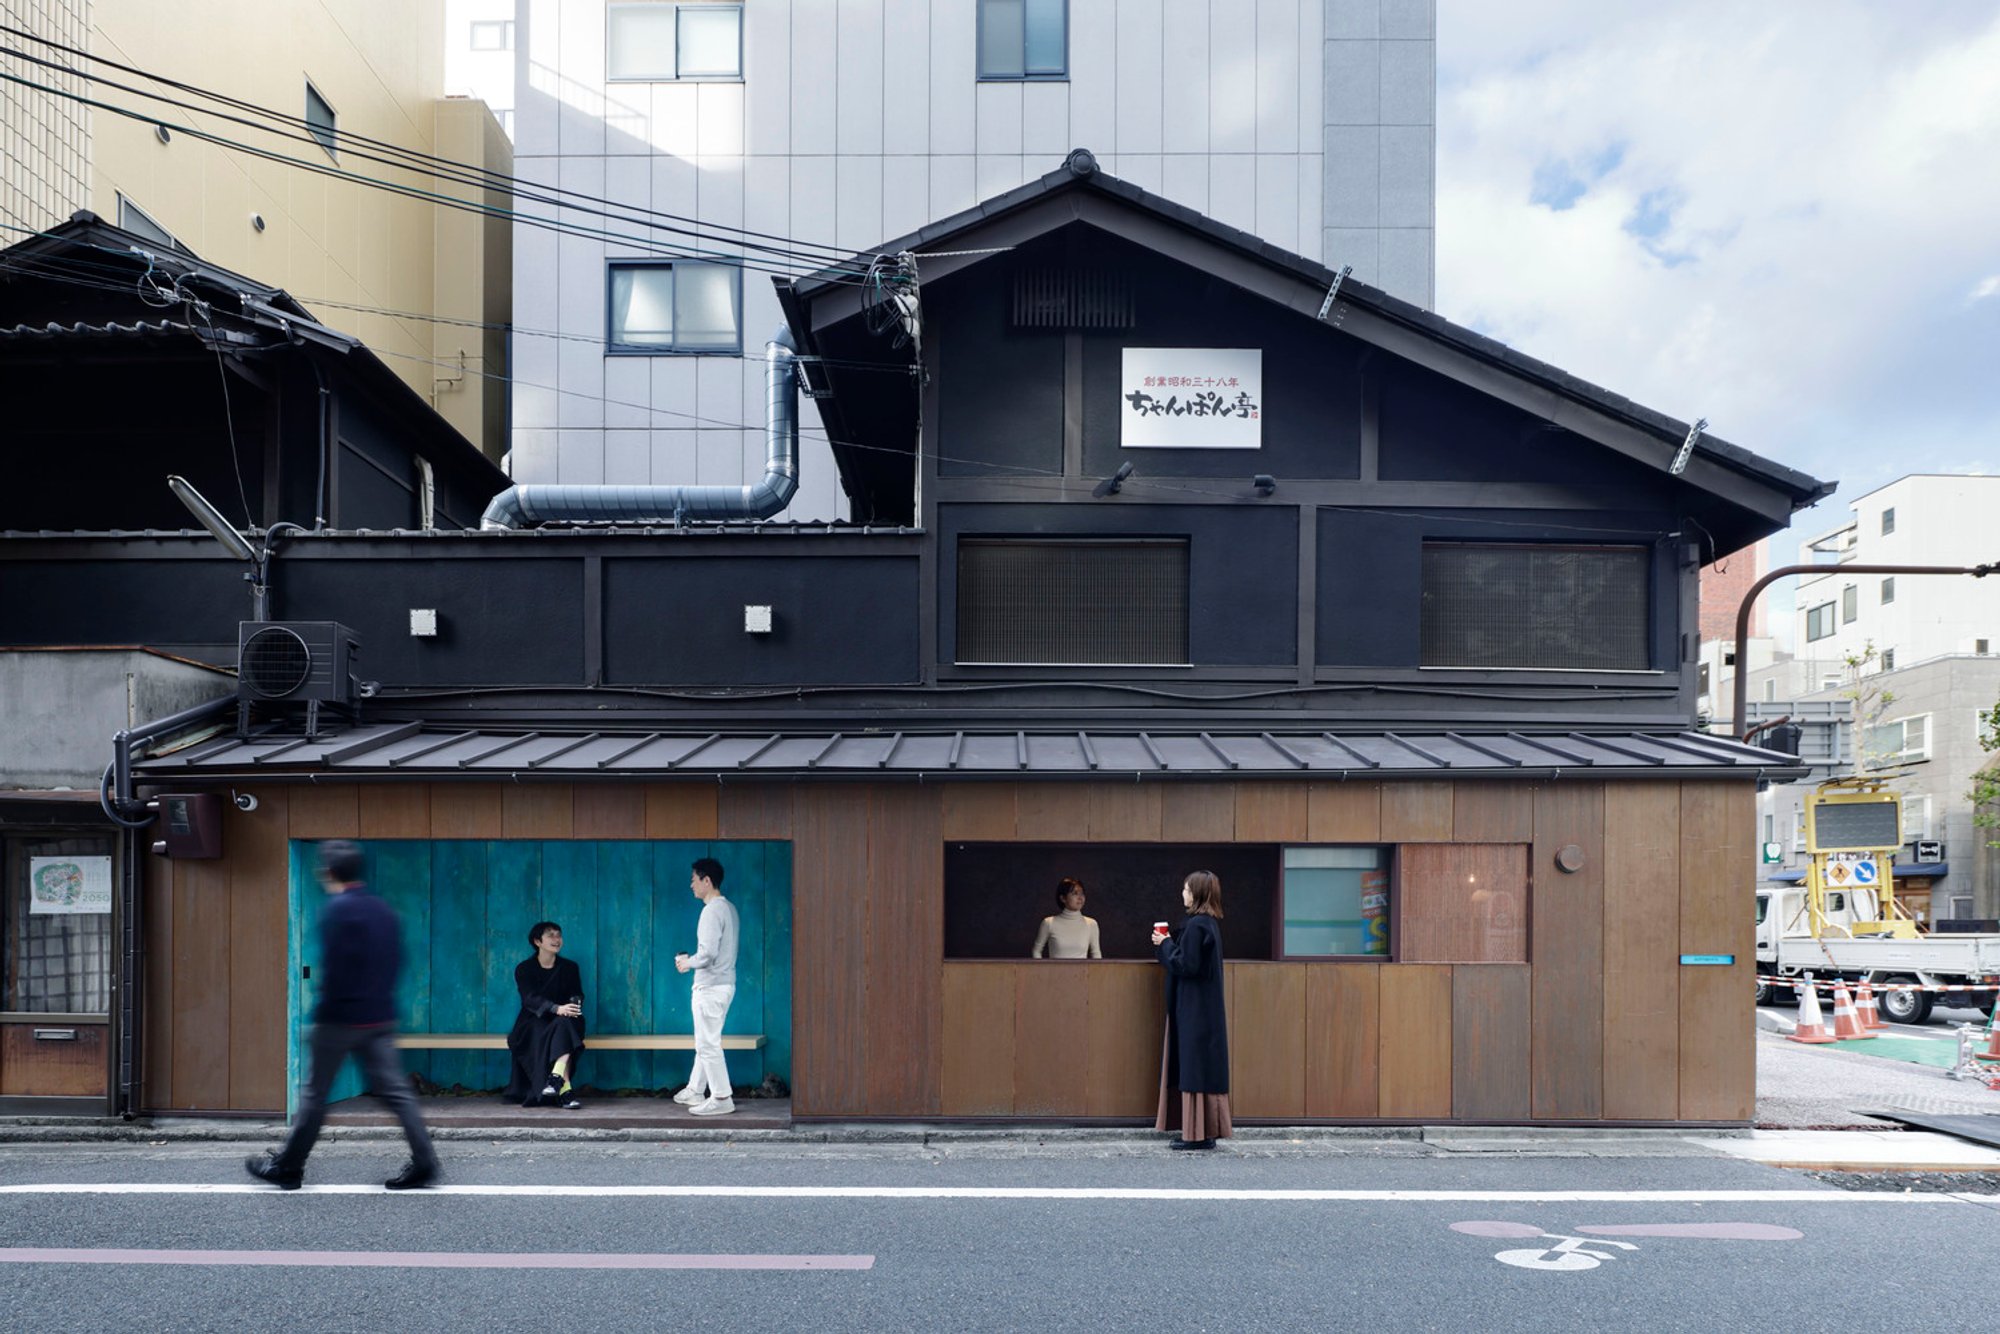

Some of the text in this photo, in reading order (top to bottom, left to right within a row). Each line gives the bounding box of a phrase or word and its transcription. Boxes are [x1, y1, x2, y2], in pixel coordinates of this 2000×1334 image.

[1144, 376, 1239, 388] 創業昭和三十八年
[1125, 390, 1257, 418] ちゃんぽん亭
[82, 894, 110, 903] 2050
